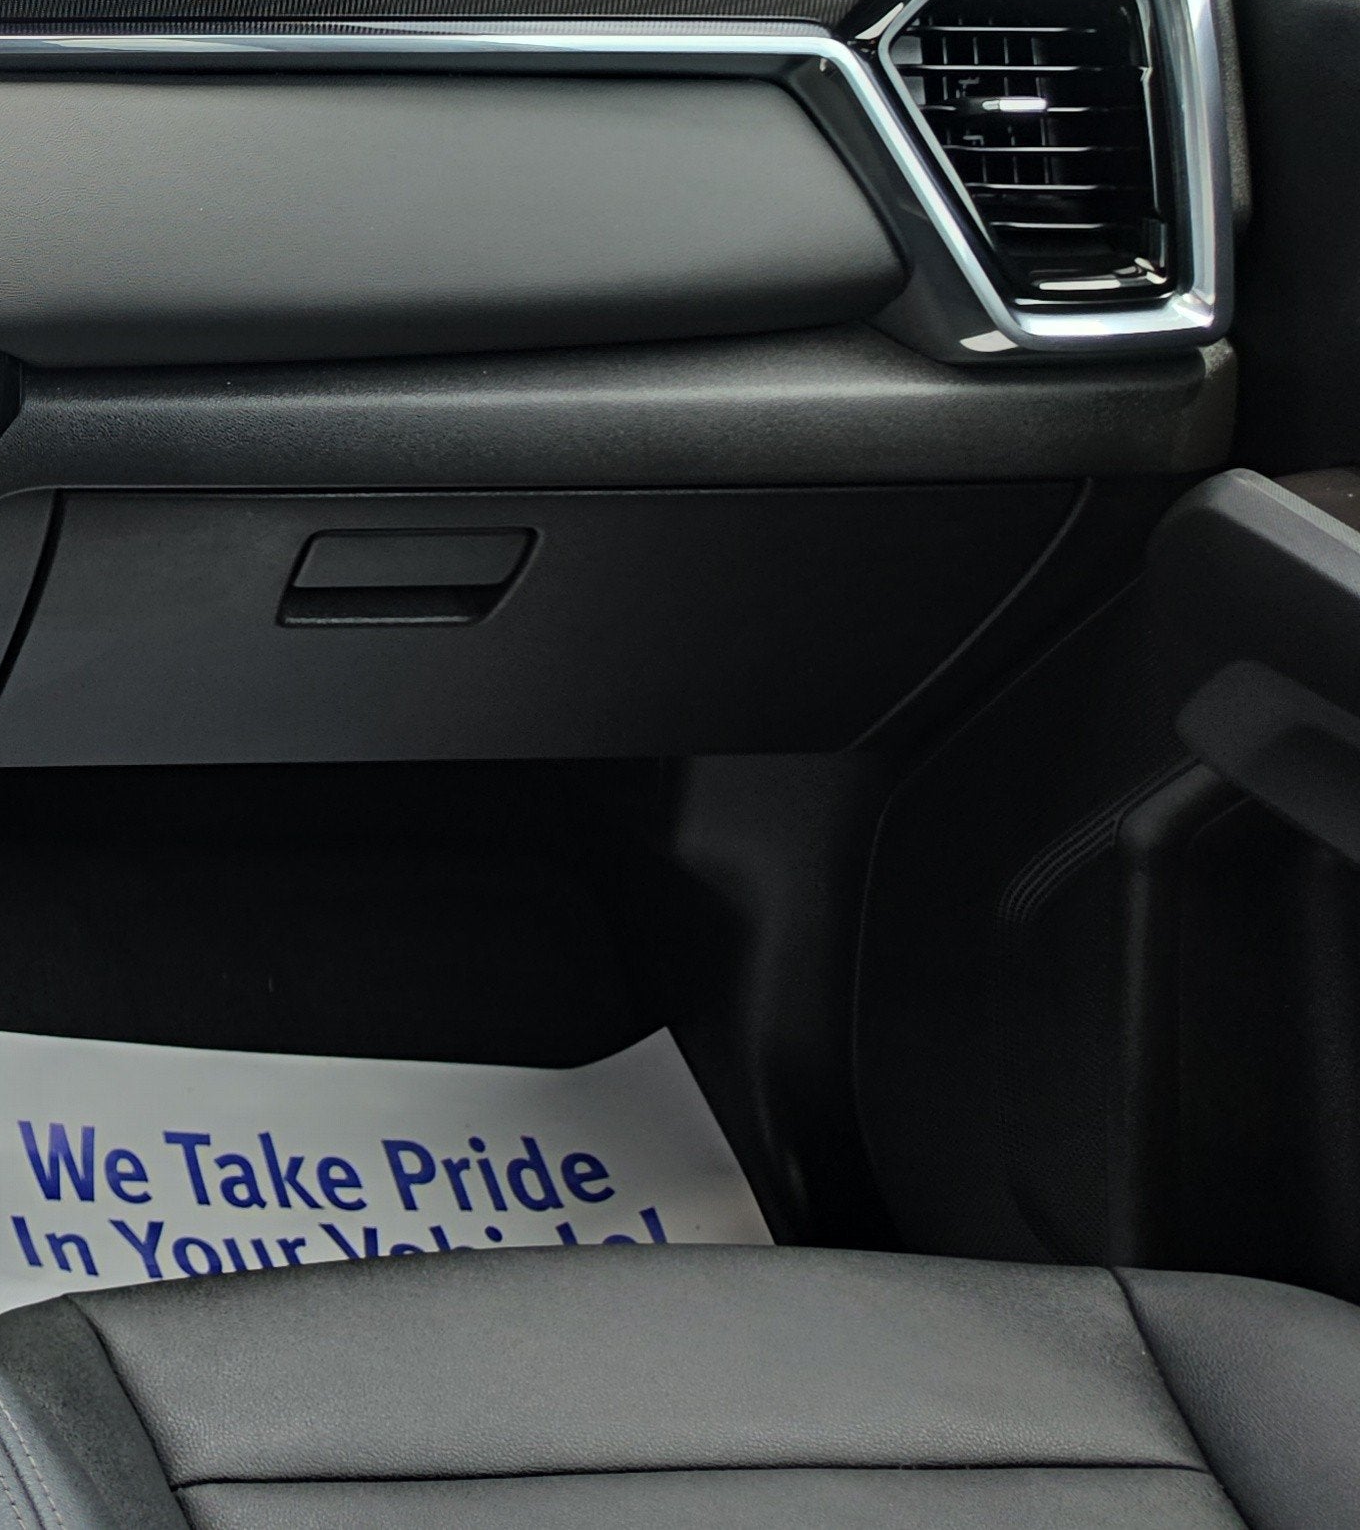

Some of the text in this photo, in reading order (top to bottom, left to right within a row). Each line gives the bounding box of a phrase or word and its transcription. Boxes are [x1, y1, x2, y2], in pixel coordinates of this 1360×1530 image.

[17, 1119, 617, 1216] We Take Pride
[11, 1213, 101, 1278] In
[109, 1218, 307, 1280] Your
